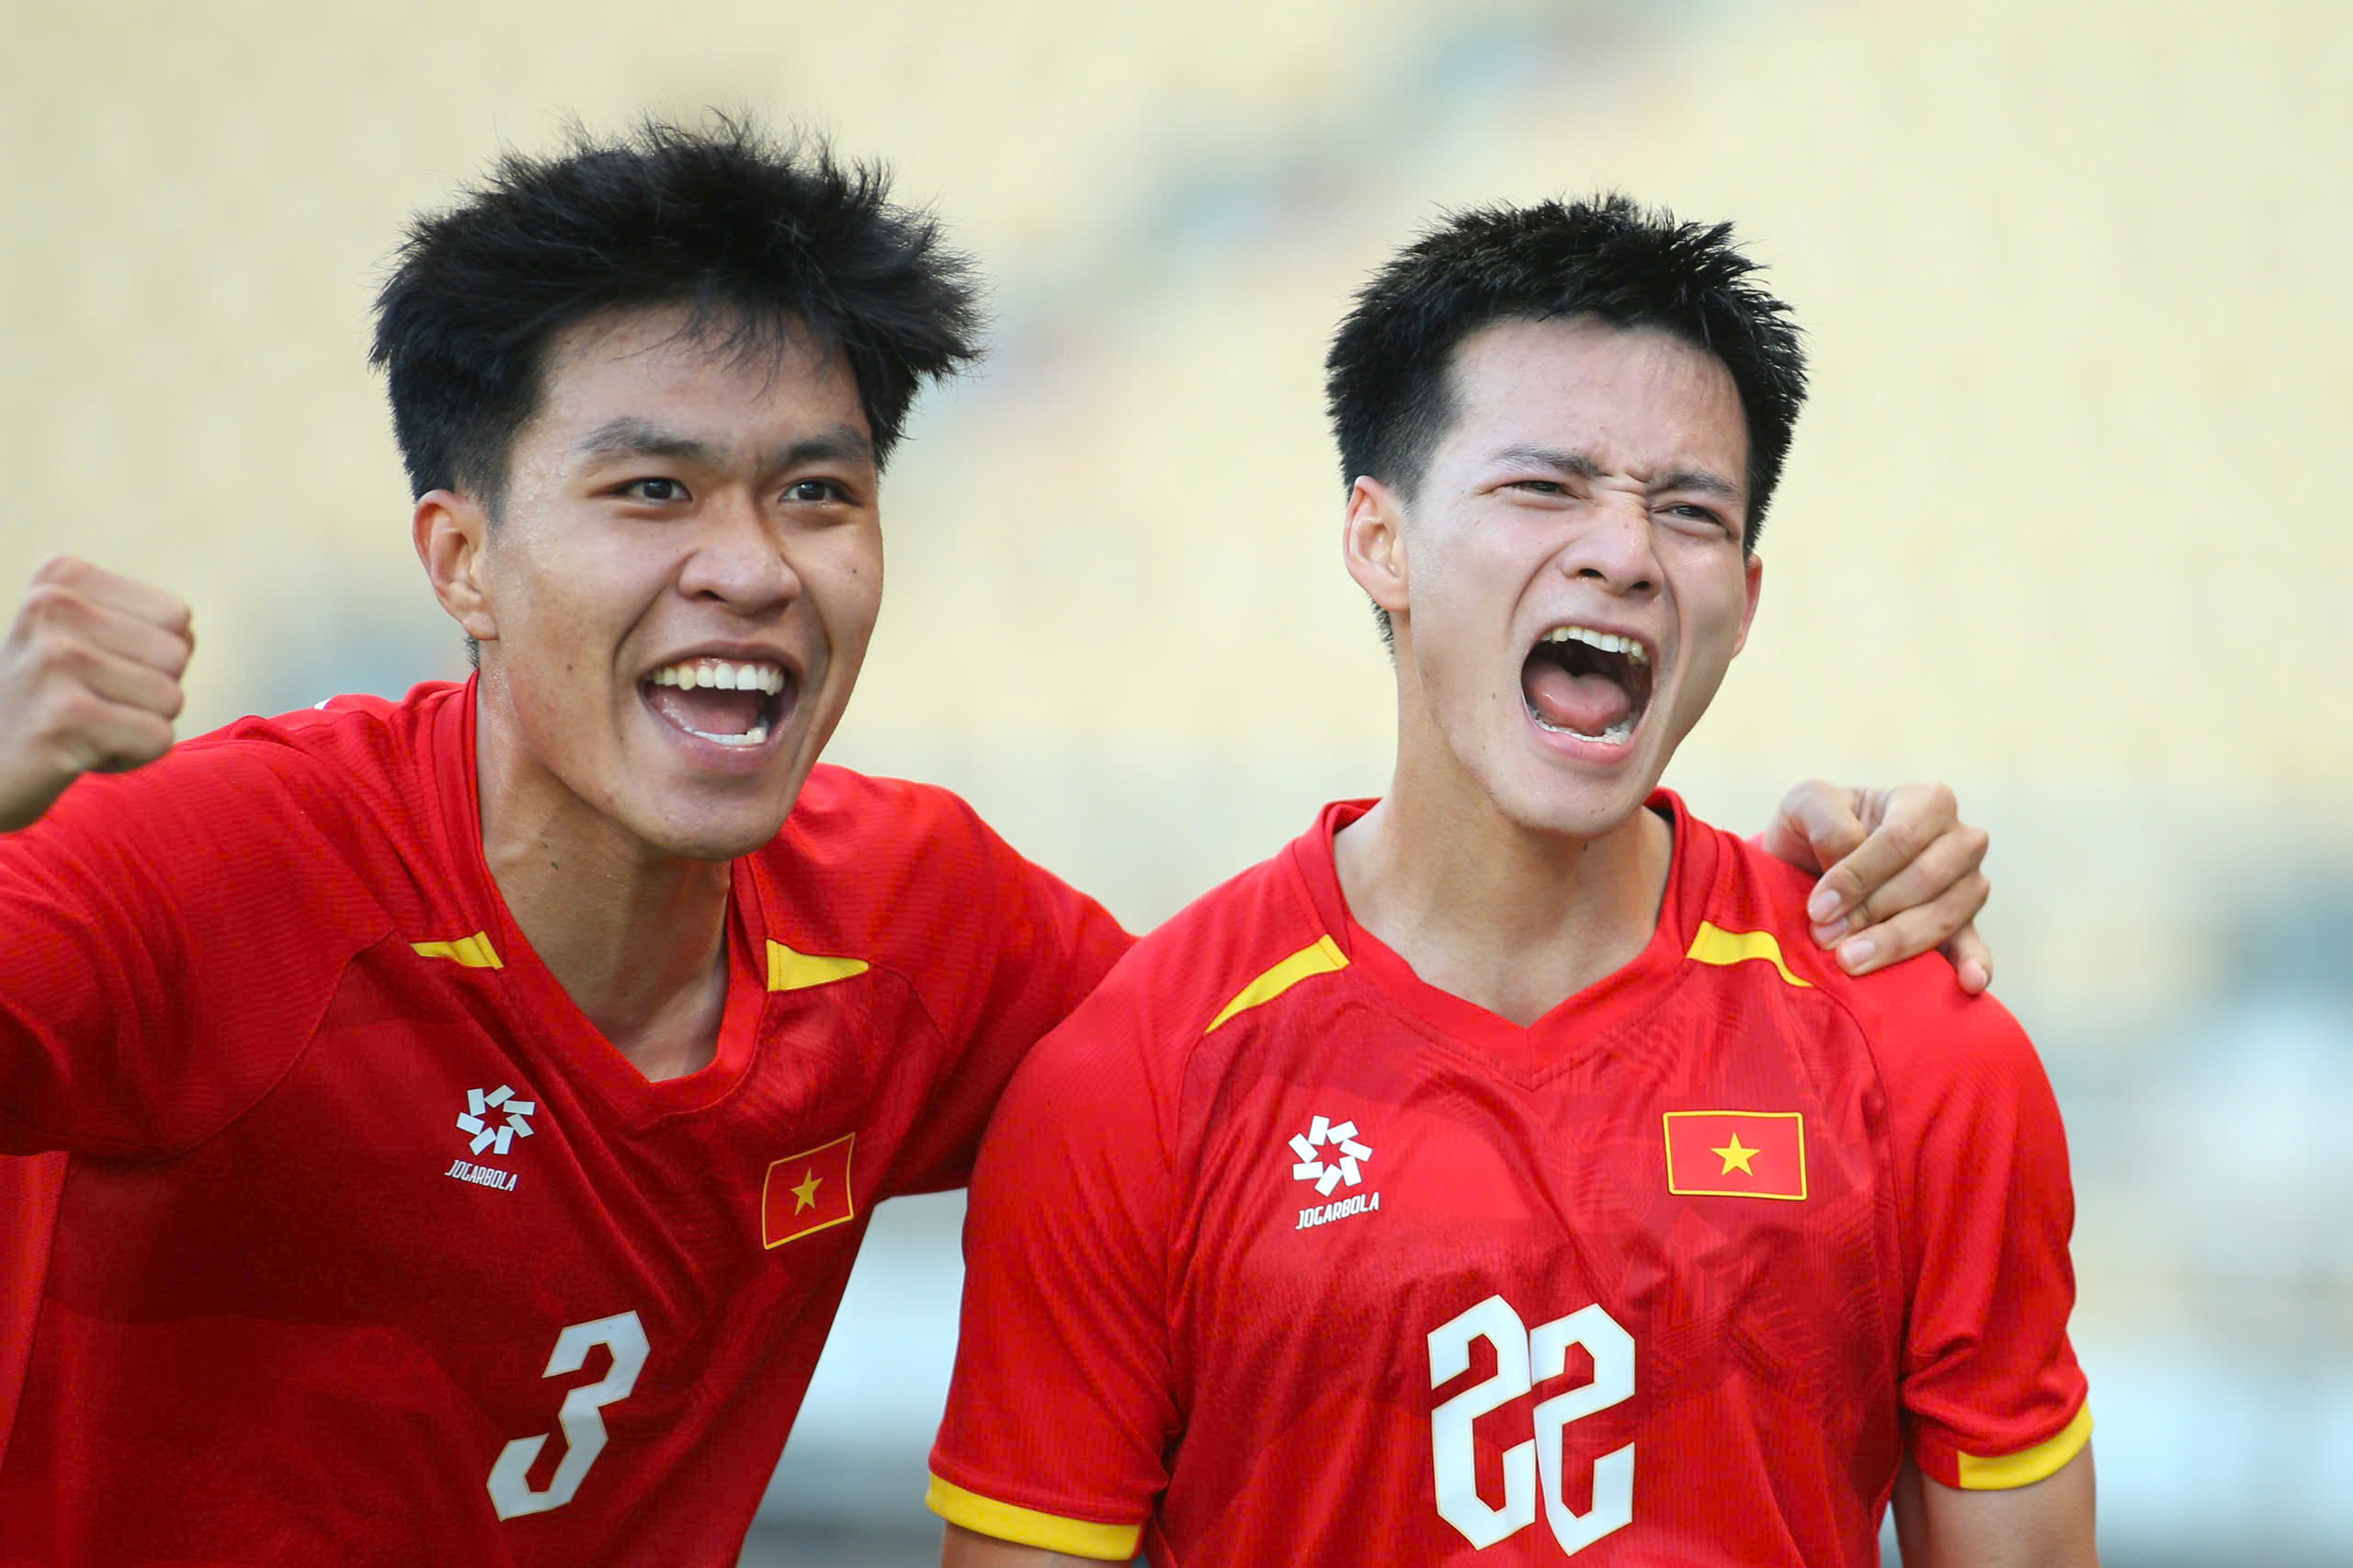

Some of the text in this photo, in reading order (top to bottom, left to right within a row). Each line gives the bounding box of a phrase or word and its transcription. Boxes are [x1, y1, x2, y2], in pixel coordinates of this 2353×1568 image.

[444, 1159, 517, 1192] JOGARBOLA
[1294, 1191, 1381, 1230] JOGARBOLA
[486, 1310, 652, 1522] 3
[1427, 1294, 1636, 1557] 22
